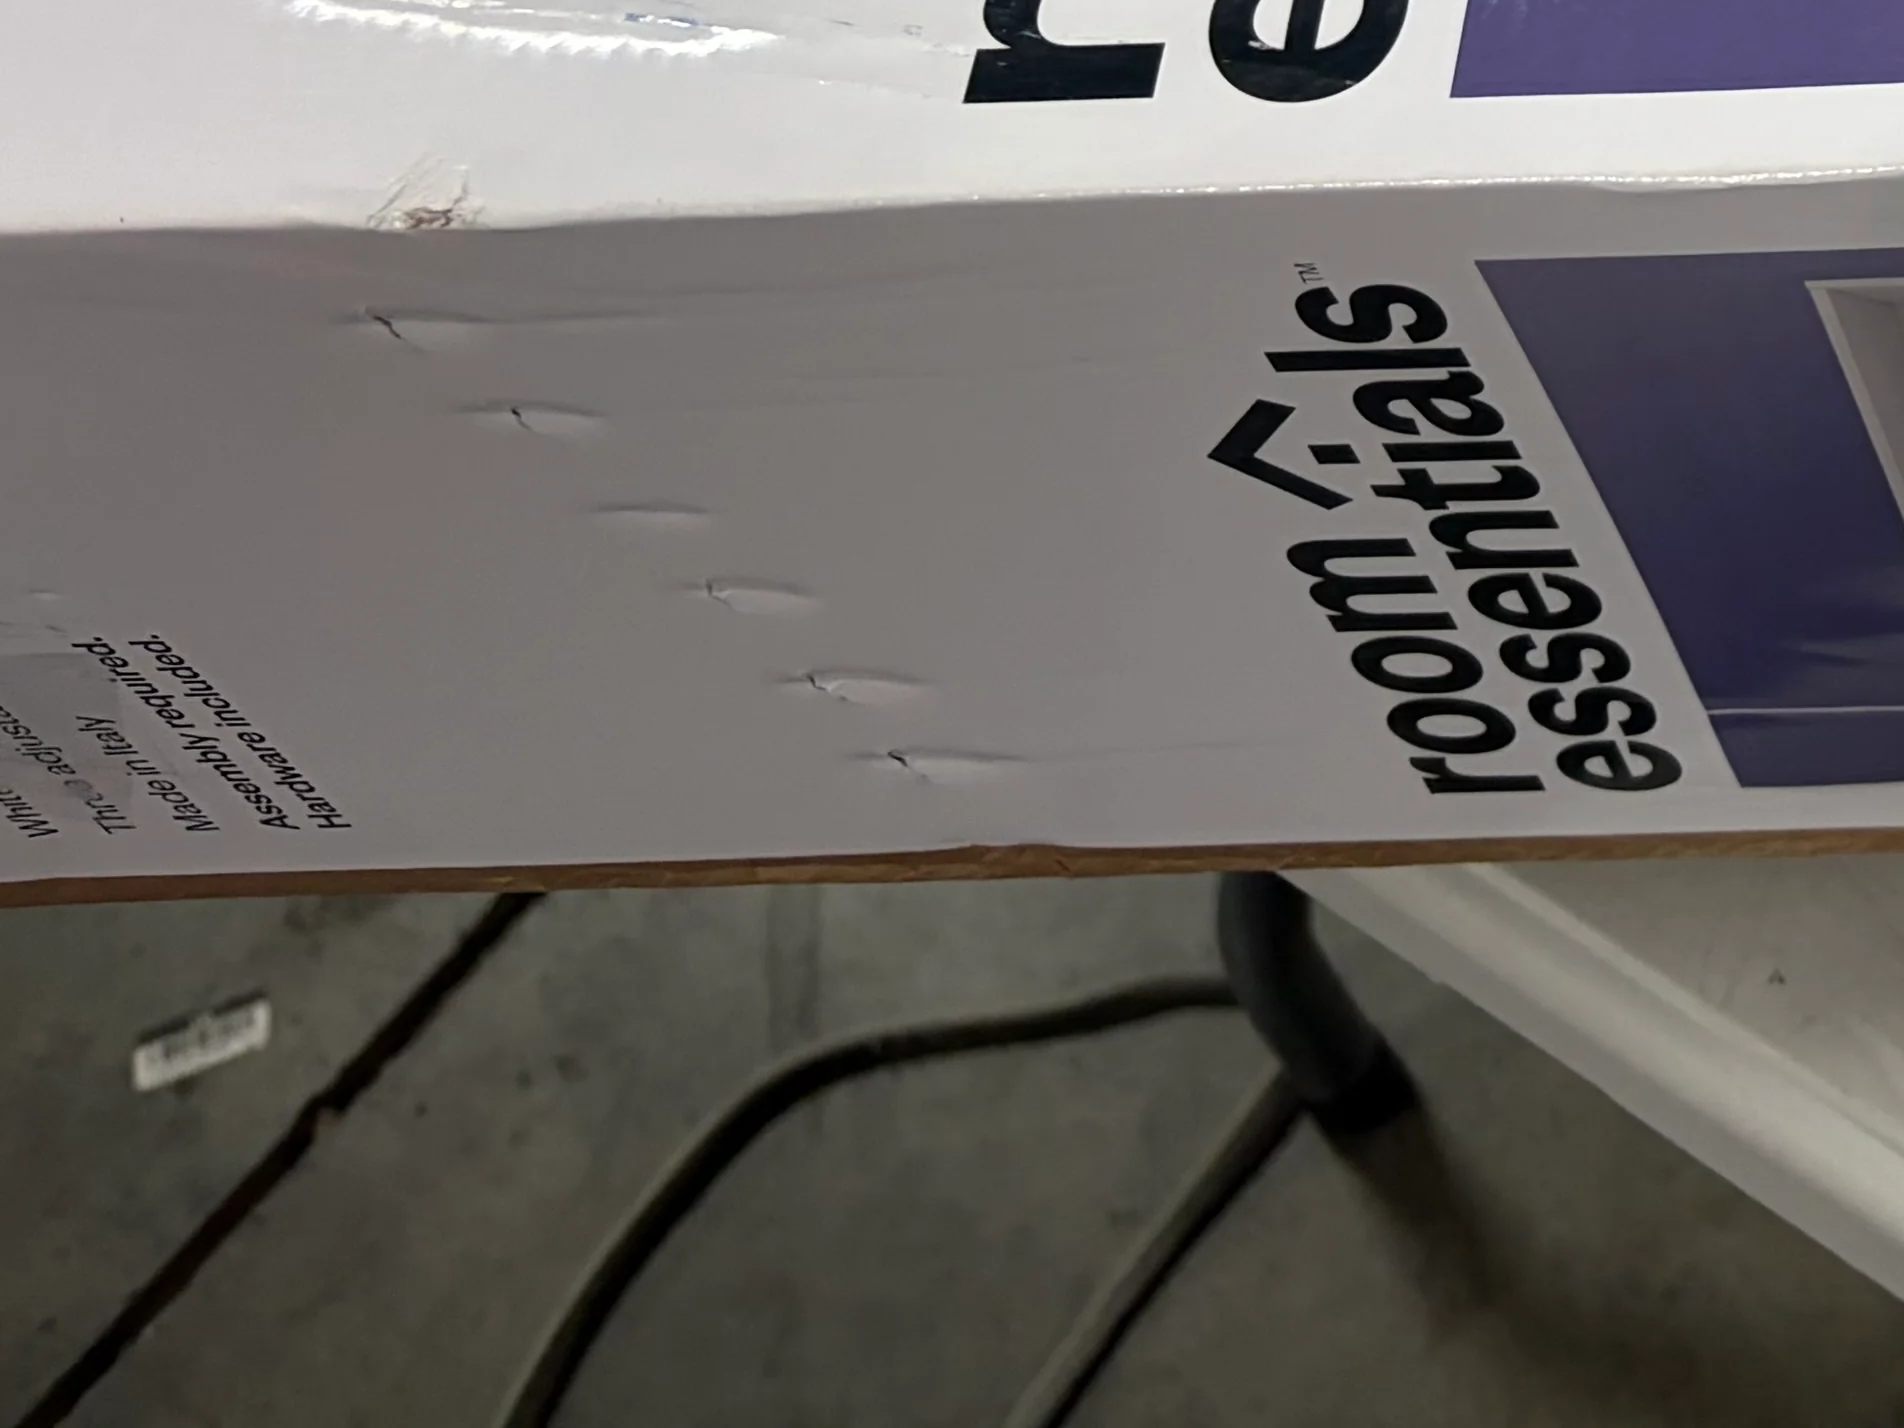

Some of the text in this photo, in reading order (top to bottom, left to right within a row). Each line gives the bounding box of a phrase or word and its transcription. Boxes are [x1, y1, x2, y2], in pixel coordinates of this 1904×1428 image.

[1264, 283, 1683, 791] essentials
[71, 637, 300, 831] Assembly required.
[128, 634, 352, 829] Hardware included.
[1286, 537, 1546, 794] room
[76, 716, 219, 831] Made in Italy
